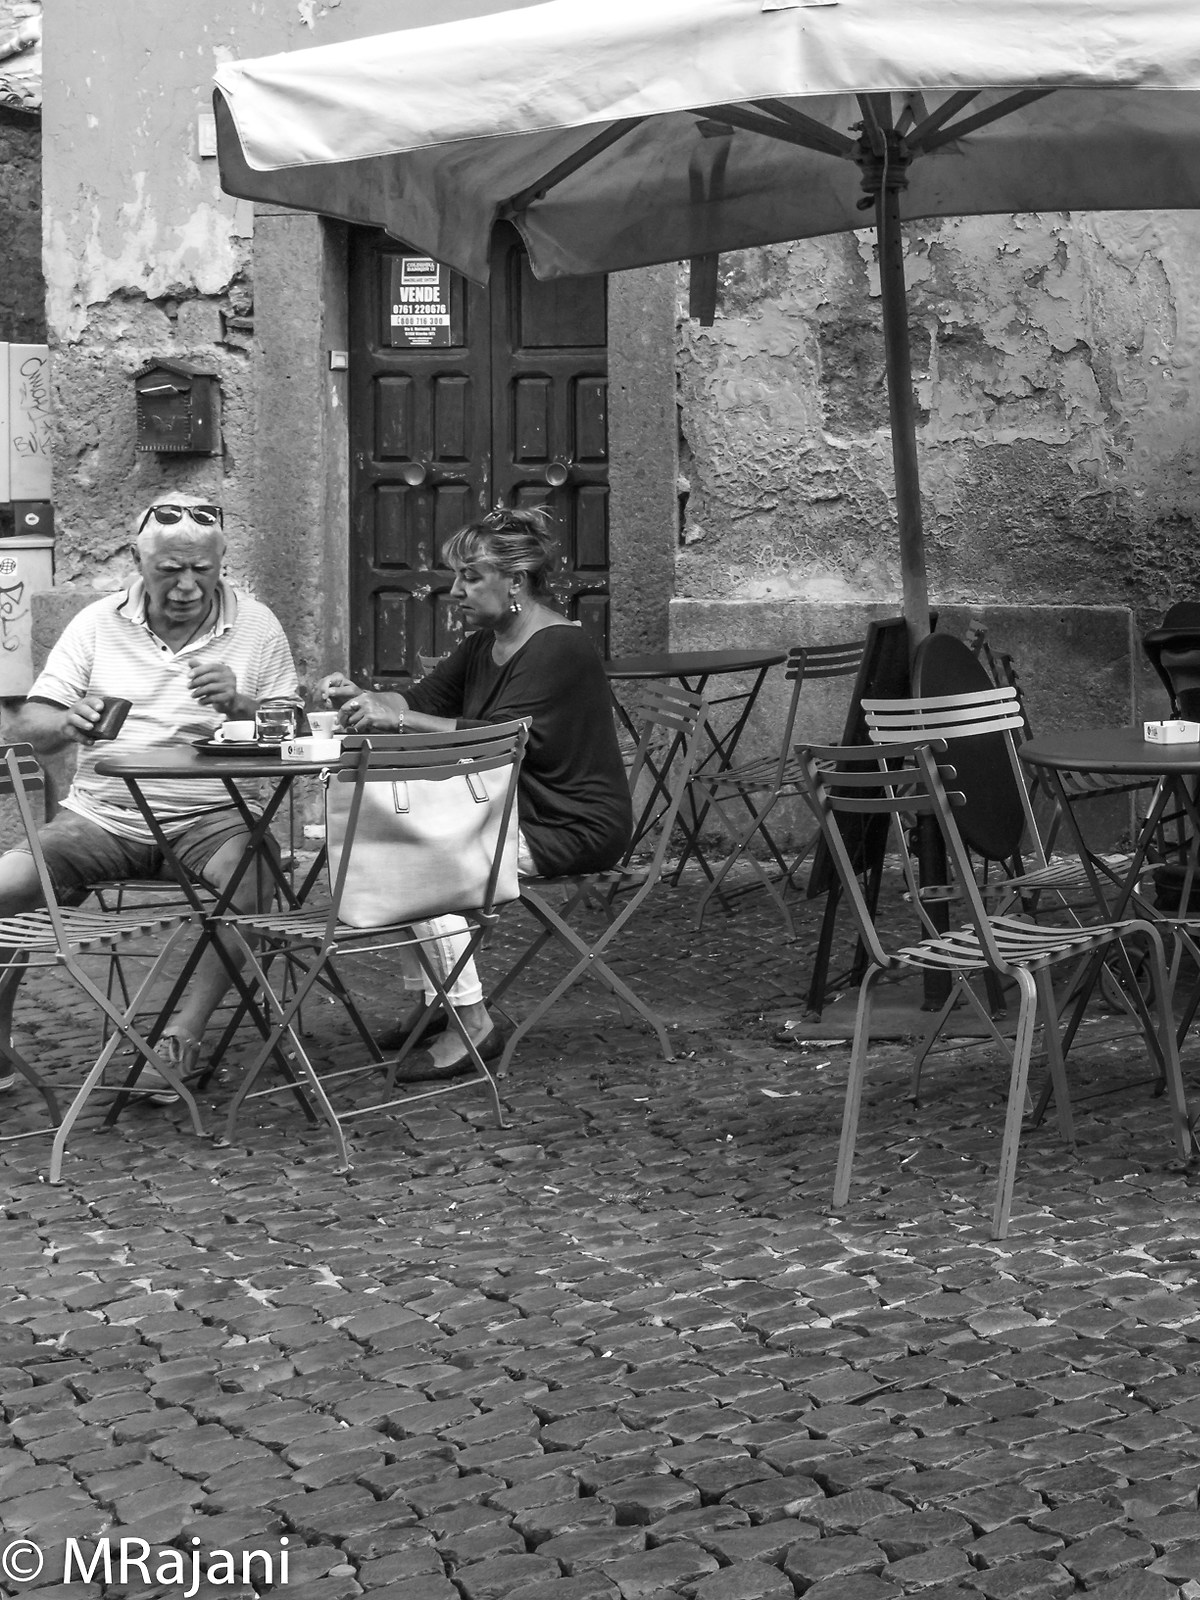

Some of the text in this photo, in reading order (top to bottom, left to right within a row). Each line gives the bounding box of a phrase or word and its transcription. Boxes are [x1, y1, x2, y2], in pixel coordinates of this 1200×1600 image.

[400, 286, 440, 303] VENDE
[393, 304, 446, 314] 0761 220676
[429, 317, 443, 325] 300
